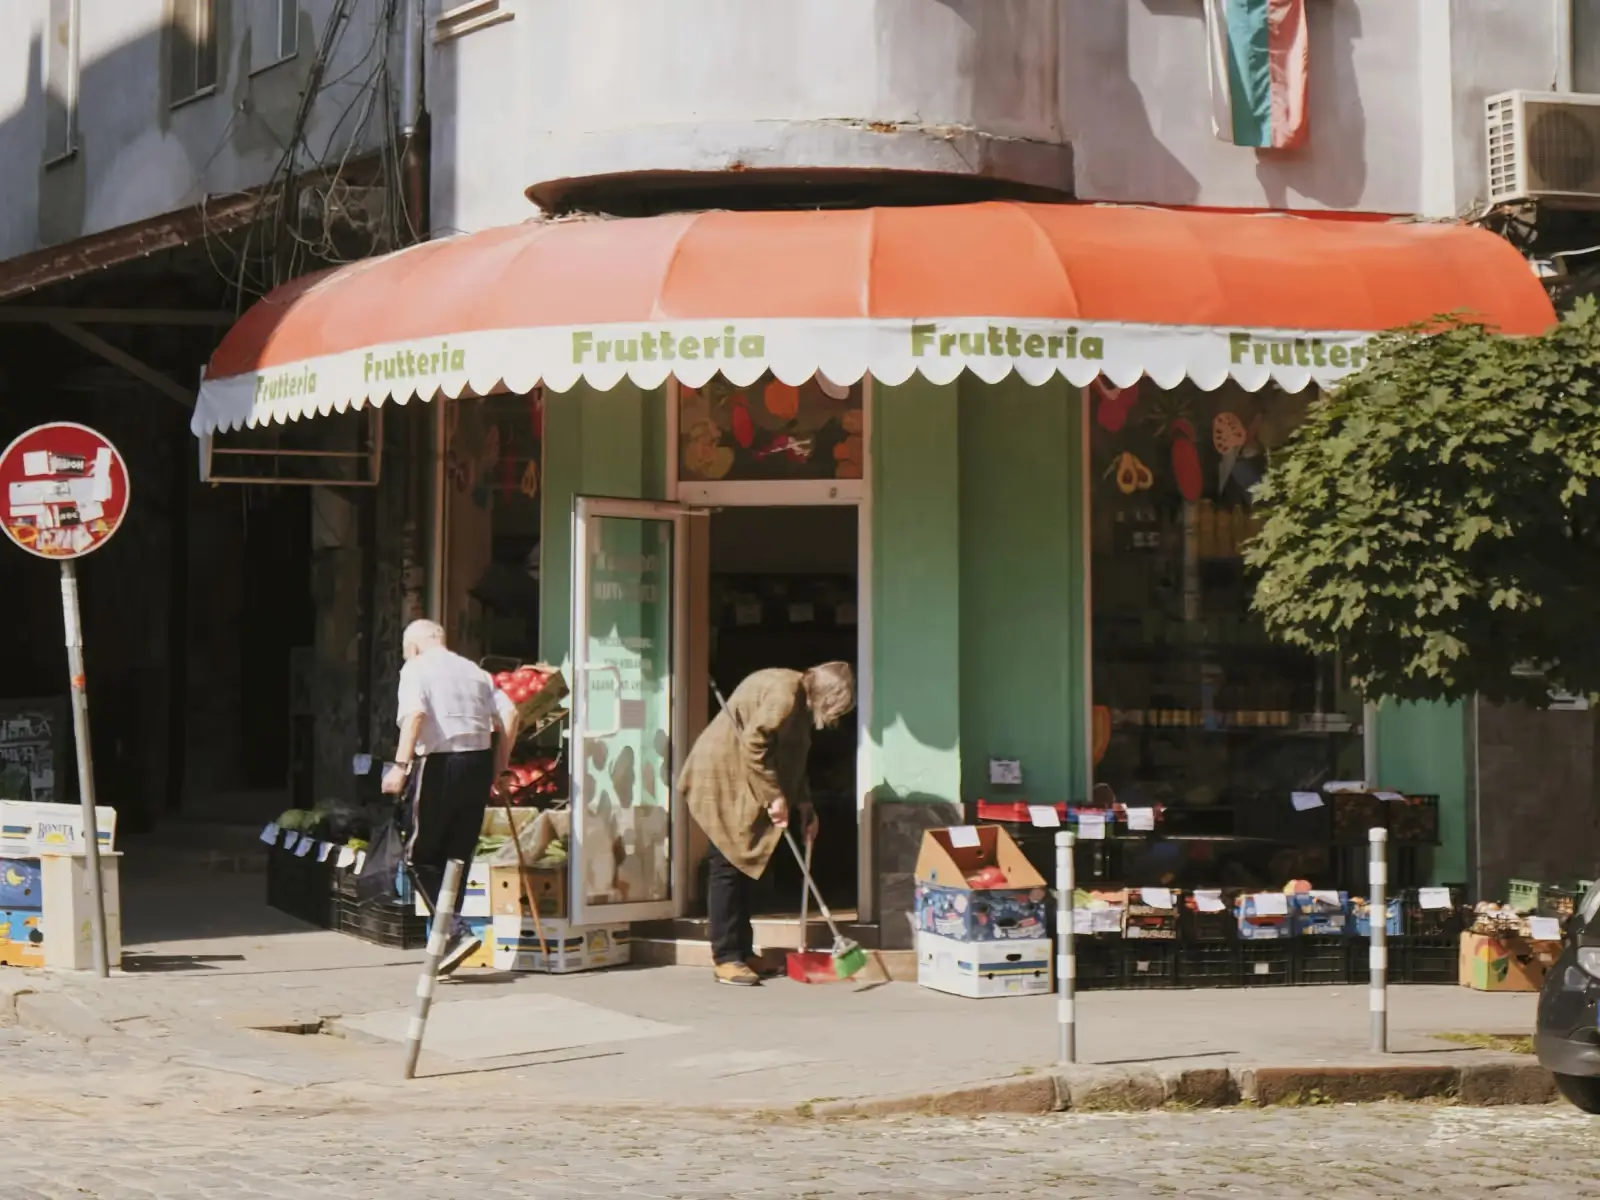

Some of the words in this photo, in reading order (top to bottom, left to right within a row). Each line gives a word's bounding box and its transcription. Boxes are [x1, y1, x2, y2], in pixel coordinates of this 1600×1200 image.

[572, 326, 764, 364] Frutteria
[911, 324, 1104, 361] Frutteria
[1229, 332, 1366, 368] Frutter
[364, 342, 465, 383] Frutteria
[254, 366, 317, 404] Frutteria
[38, 822, 74, 841] BONITA
